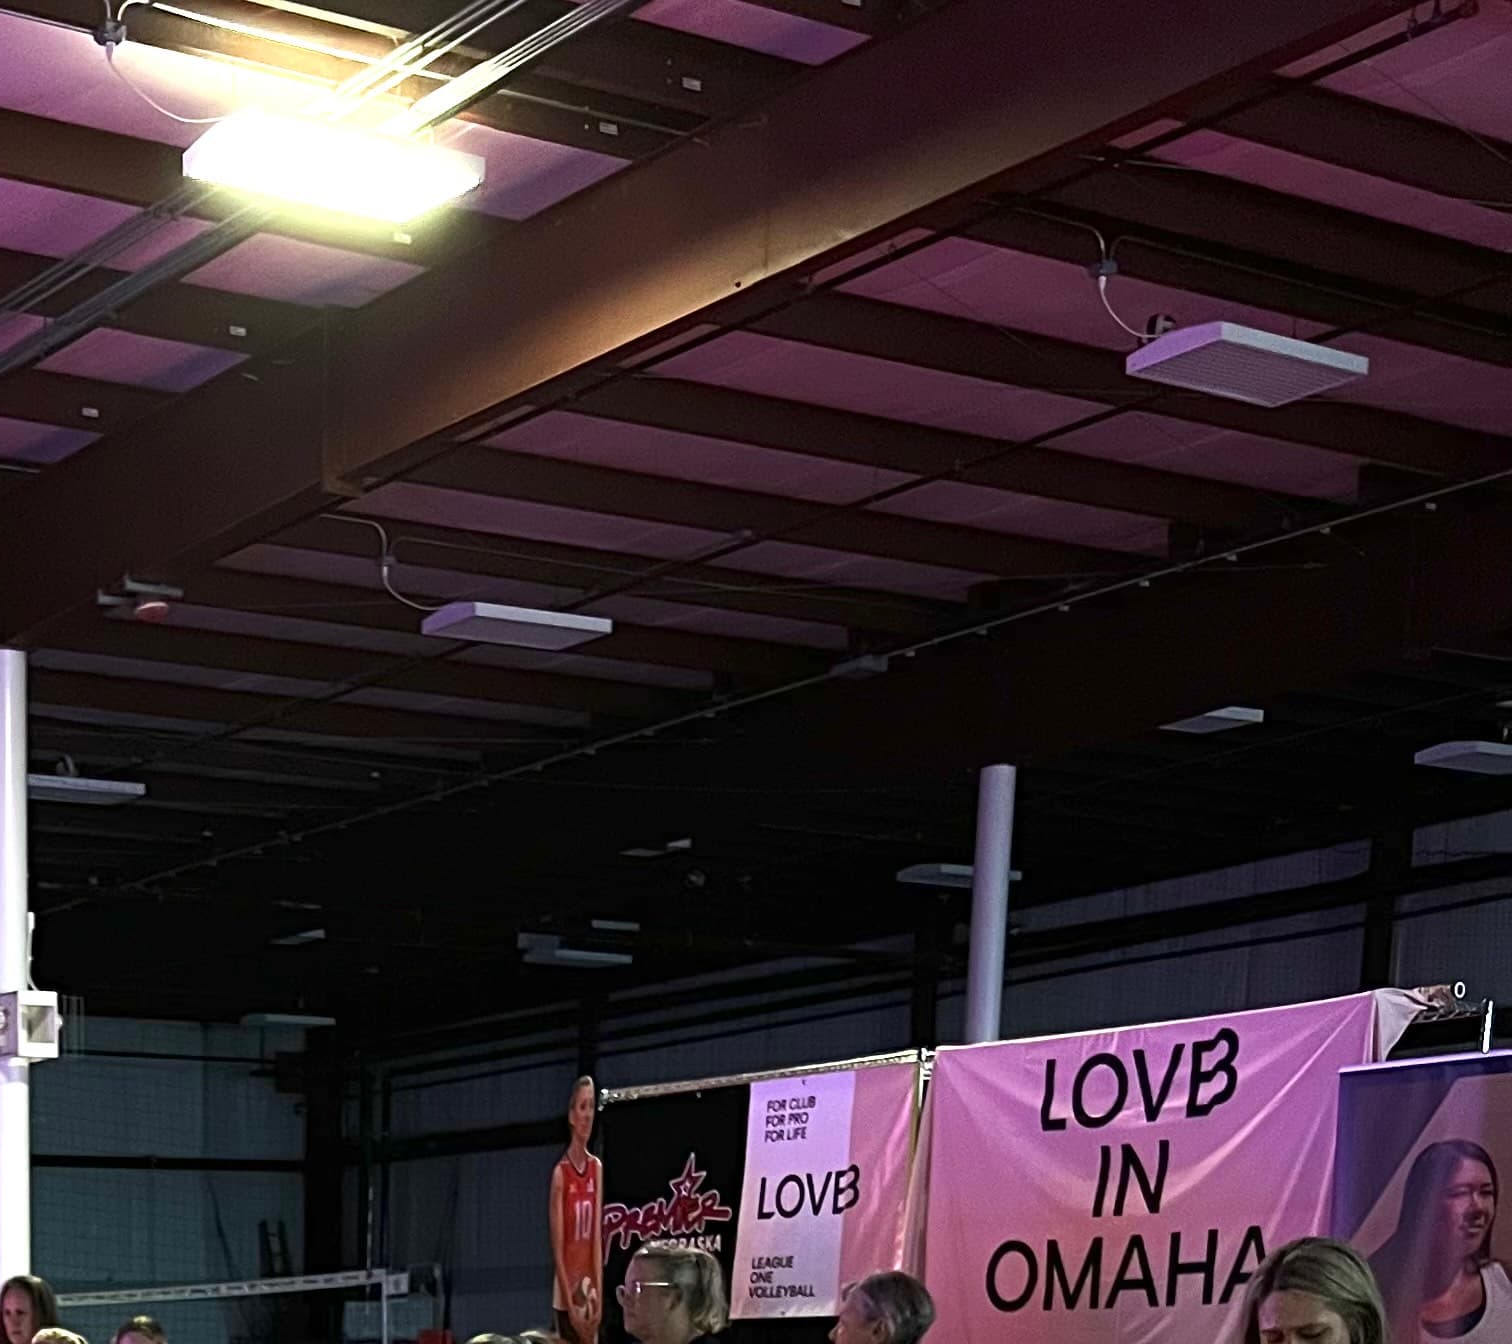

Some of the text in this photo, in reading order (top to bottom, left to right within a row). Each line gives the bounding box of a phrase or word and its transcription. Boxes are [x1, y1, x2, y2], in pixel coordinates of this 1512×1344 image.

[1040, 1027, 1240, 1132] LOVB
[767, 1096, 816, 1113] FOR CLUB
[765, 1112, 809, 1128] FOR PRO
[764, 1126, 807, 1142] FOR LIFE
[1092, 1140, 1170, 1218] IN
[757, 1164, 860, 1220] LOVB
[752, 1256, 794, 1269] LEAGUE
[986, 1225, 1267, 1312] OMAHA
[750, 1272, 773, 1284] ONE
[749, 1286, 815, 1299] VOLLEYBALL
